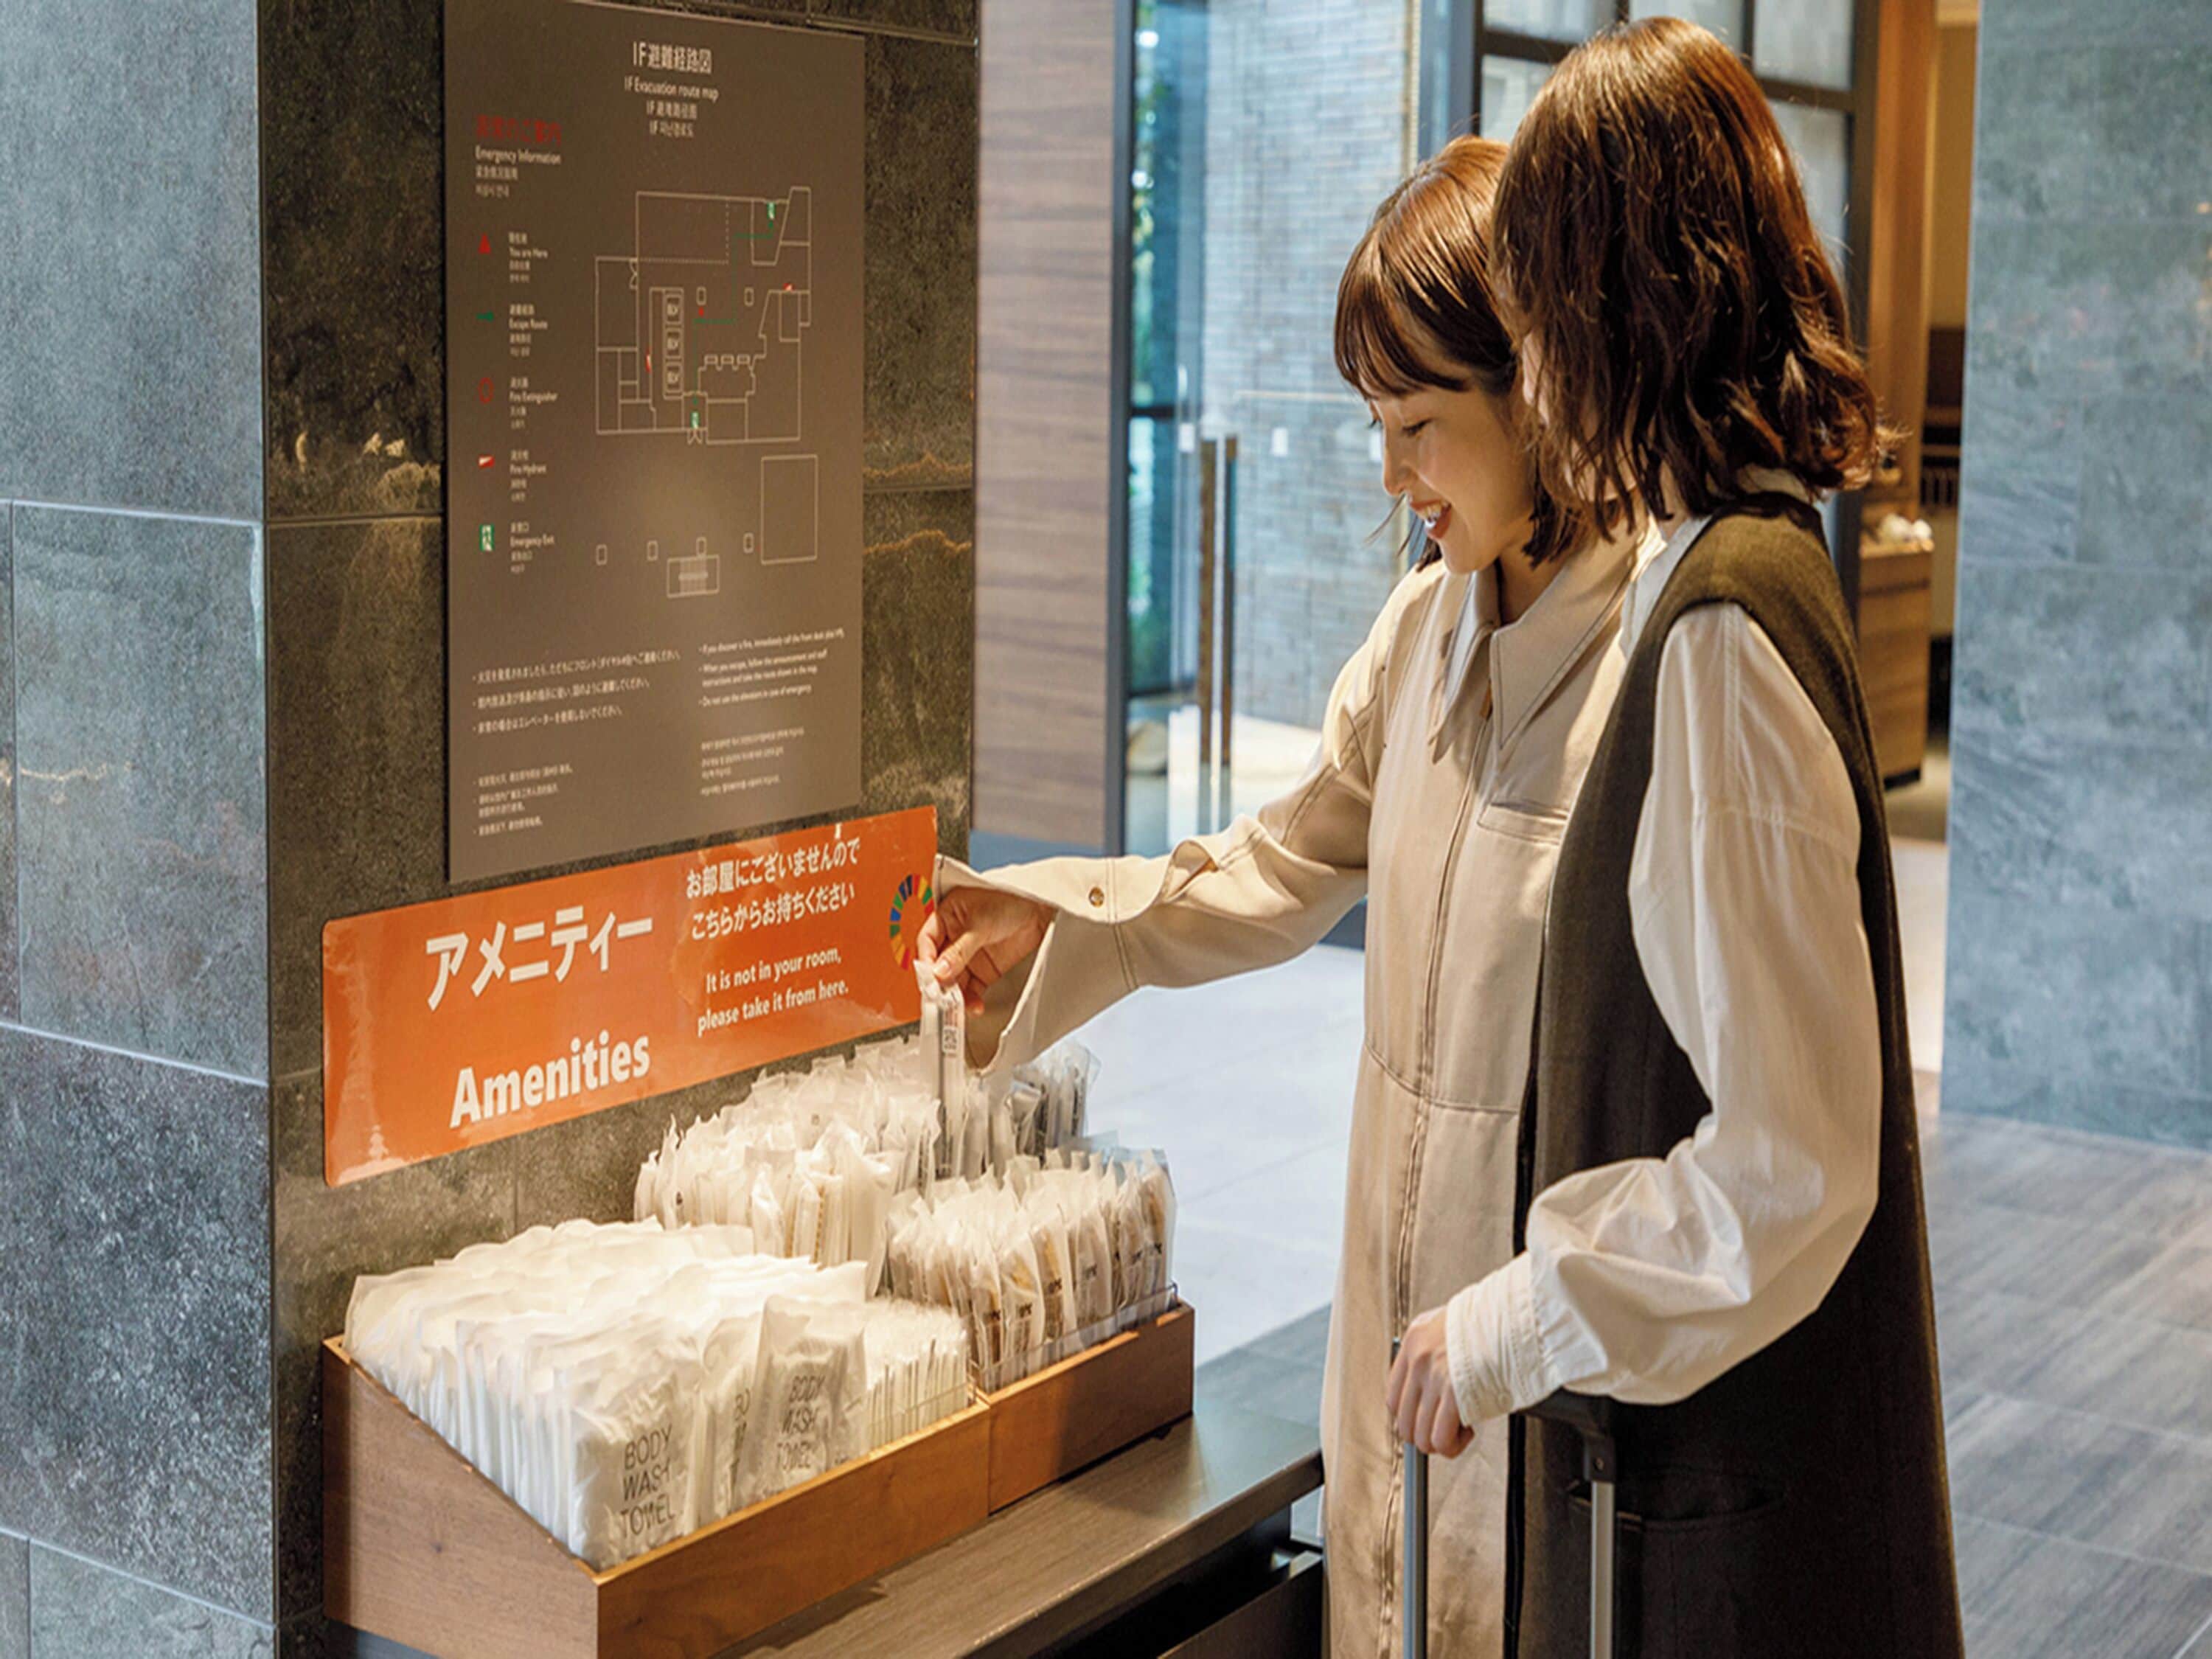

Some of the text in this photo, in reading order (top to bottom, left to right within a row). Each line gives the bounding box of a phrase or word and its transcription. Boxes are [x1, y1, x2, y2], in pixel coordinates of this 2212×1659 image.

[634, 76, 676, 94] Evacuation
[678, 84, 700, 98] route
[702, 87, 720, 103] map
[686, 836, 861, 899] お部屋にございませんので
[692, 882, 855, 940] こちらからお持ちください
[425, 905, 653, 1011] アメニティー
[706, 947, 841, 994] It is not in your room,
[698, 976, 849, 1037] please take it from here.
[449, 1029, 651, 1129] Amenities
[789, 1375, 826, 1403] BODY
[625, 1424, 672, 1470] BODY
[623, 1458, 671, 1502] WASH
[620, 1493, 675, 1539] TOWEL
